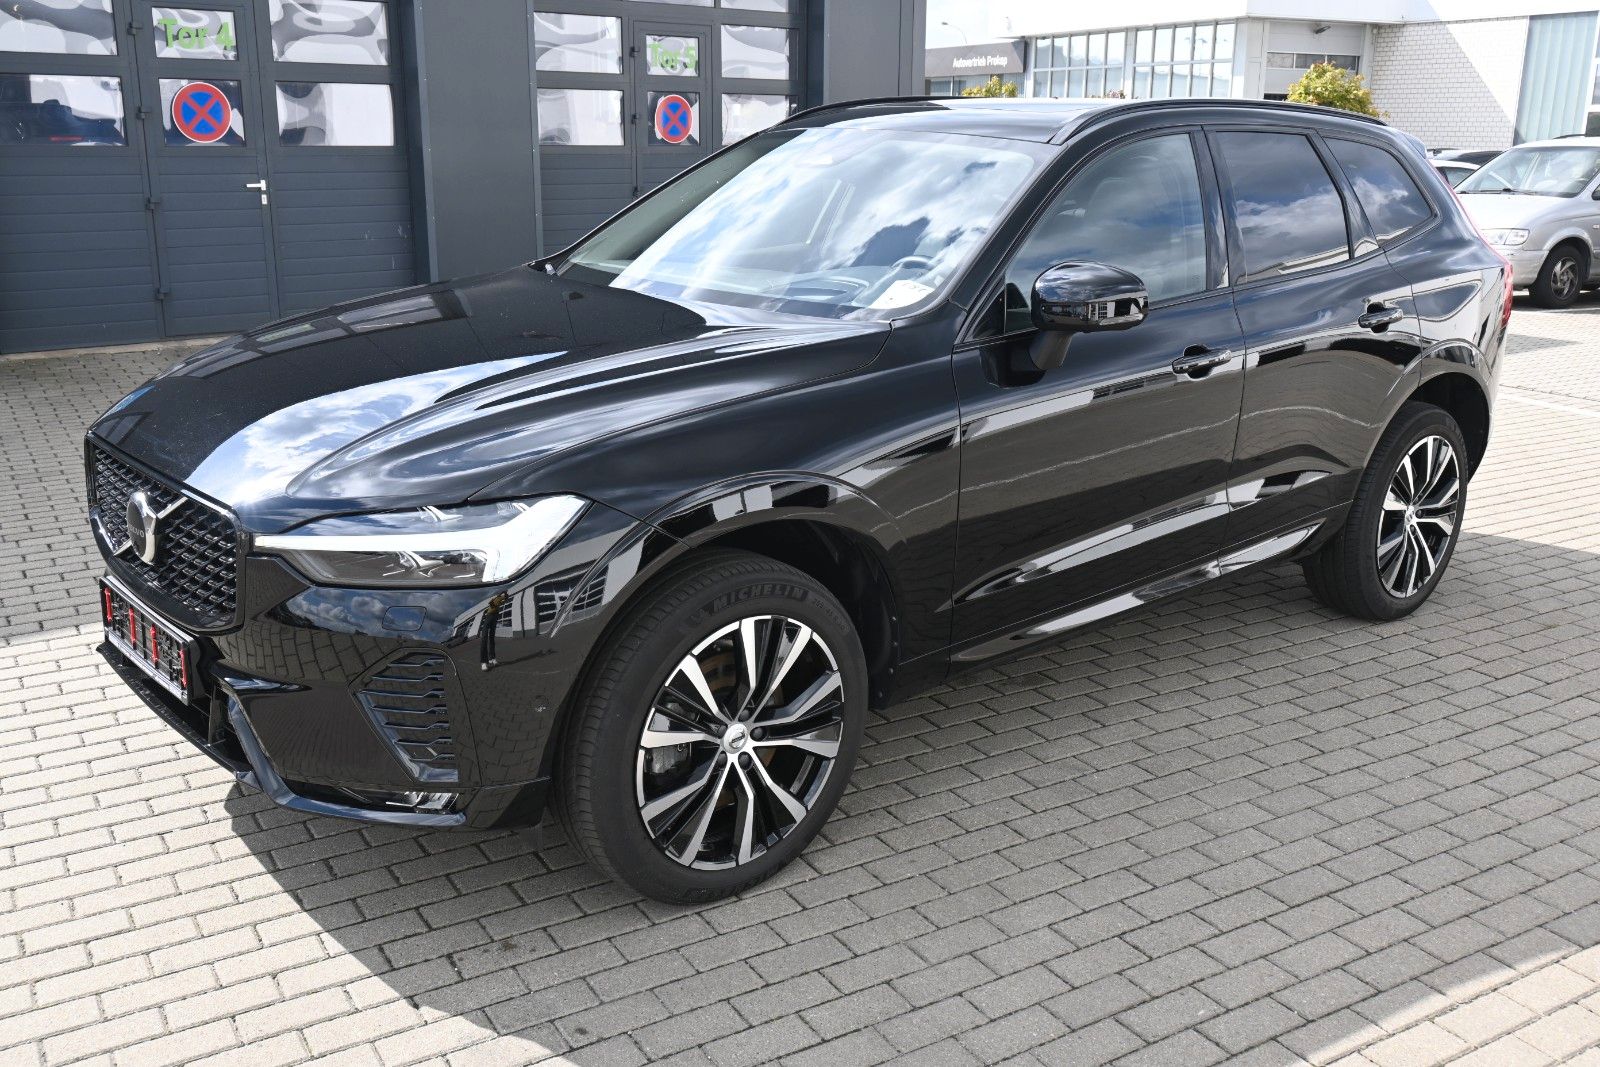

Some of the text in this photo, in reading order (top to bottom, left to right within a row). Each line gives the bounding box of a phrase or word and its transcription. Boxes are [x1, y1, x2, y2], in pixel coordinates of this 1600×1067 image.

[158, 18, 236, 51] Tor 4
[648, 43, 681, 69] Tor
[713, 583, 809, 611] MICHELIN
